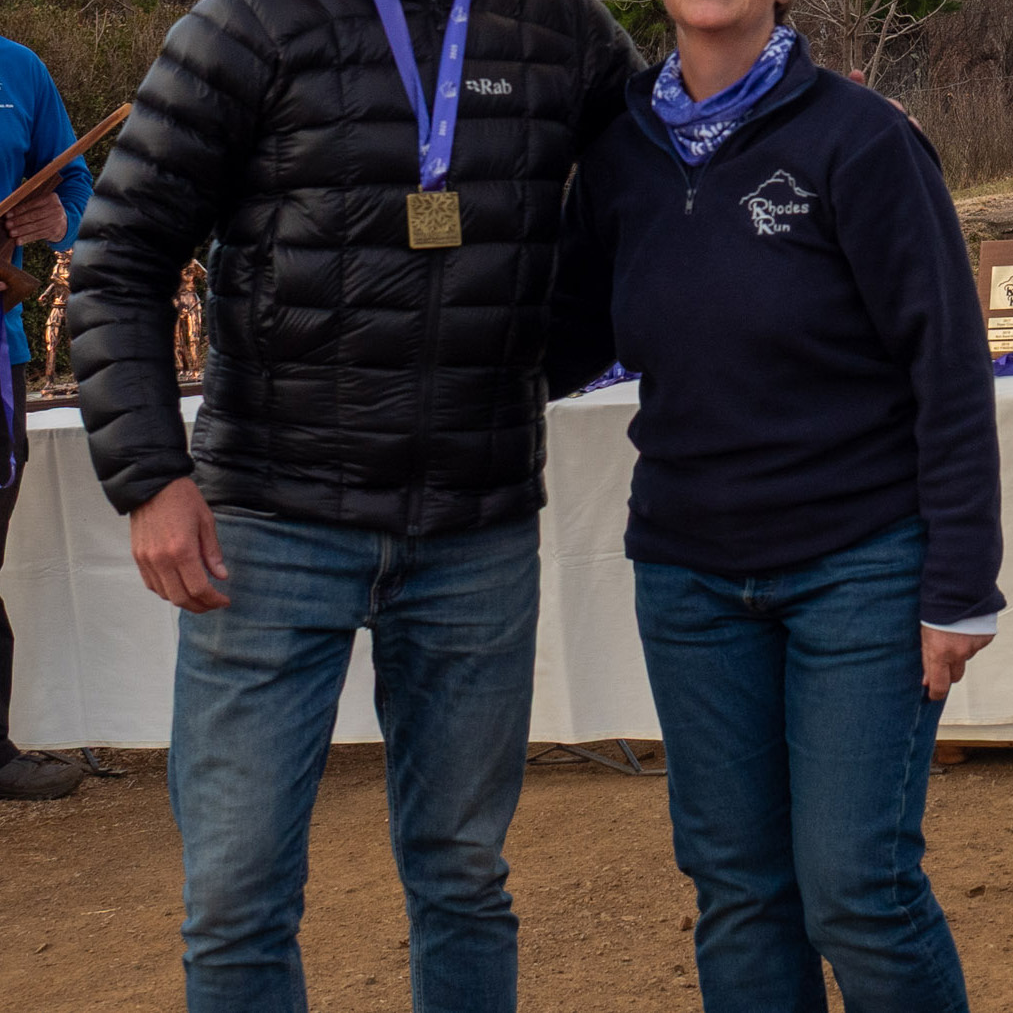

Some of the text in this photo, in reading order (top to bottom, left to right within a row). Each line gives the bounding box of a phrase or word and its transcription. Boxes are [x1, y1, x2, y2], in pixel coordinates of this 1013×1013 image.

[479, 78, 512, 95] Rab
[748, 197, 810, 220] Rhodes
[754, 214, 791, 235] Run
